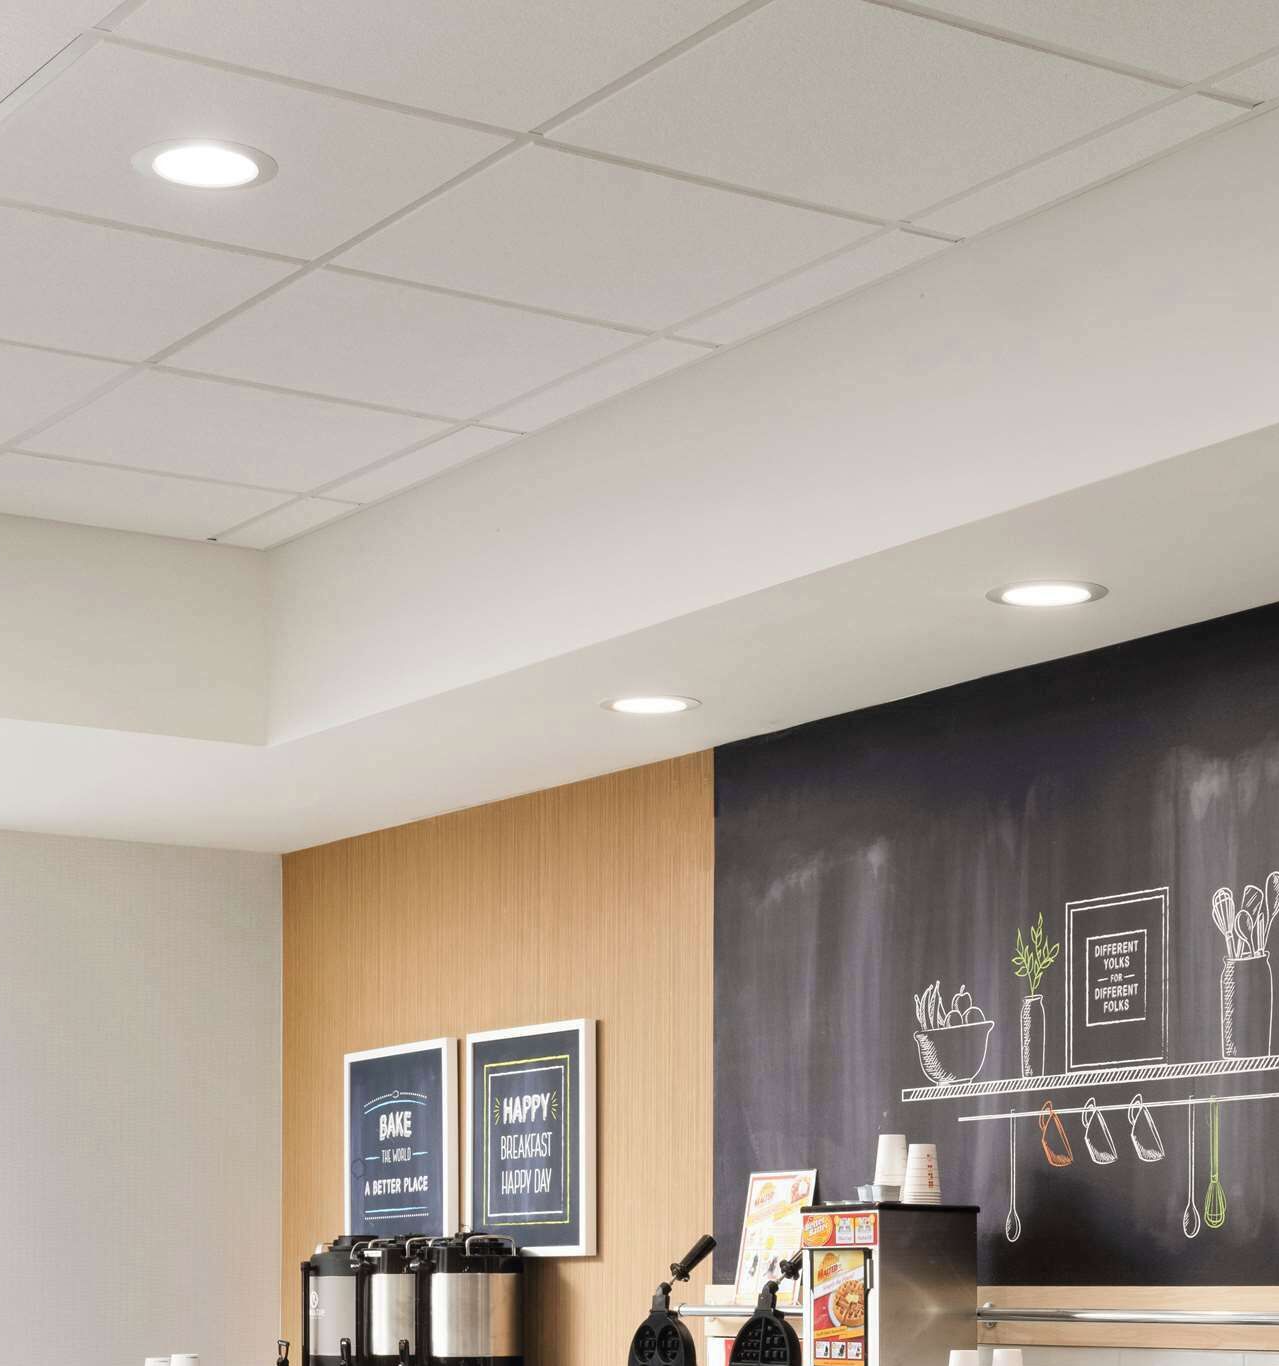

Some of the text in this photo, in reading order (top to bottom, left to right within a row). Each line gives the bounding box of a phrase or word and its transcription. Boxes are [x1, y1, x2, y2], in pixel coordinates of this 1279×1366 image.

[1094, 940, 1139, 958] DIFFERENT
[1103, 955, 1130, 970] YOLKS
[1110, 973, 1123, 982] FOR
[1094, 983, 1139, 1000] DIFFERENT
[1103, 998, 1130, 1013] FOLKS
[502, 1093, 550, 1124] HAPPY
[379, 1111, 412, 1141] BAKE
[382, 1147, 412, 1163] THE WORLD
[500, 1131, 552, 1161] BREAKFAST
[364, 1175, 429, 1197] A BETTER PLACE
[501, 1168, 552, 1195] HAPPY DAY
